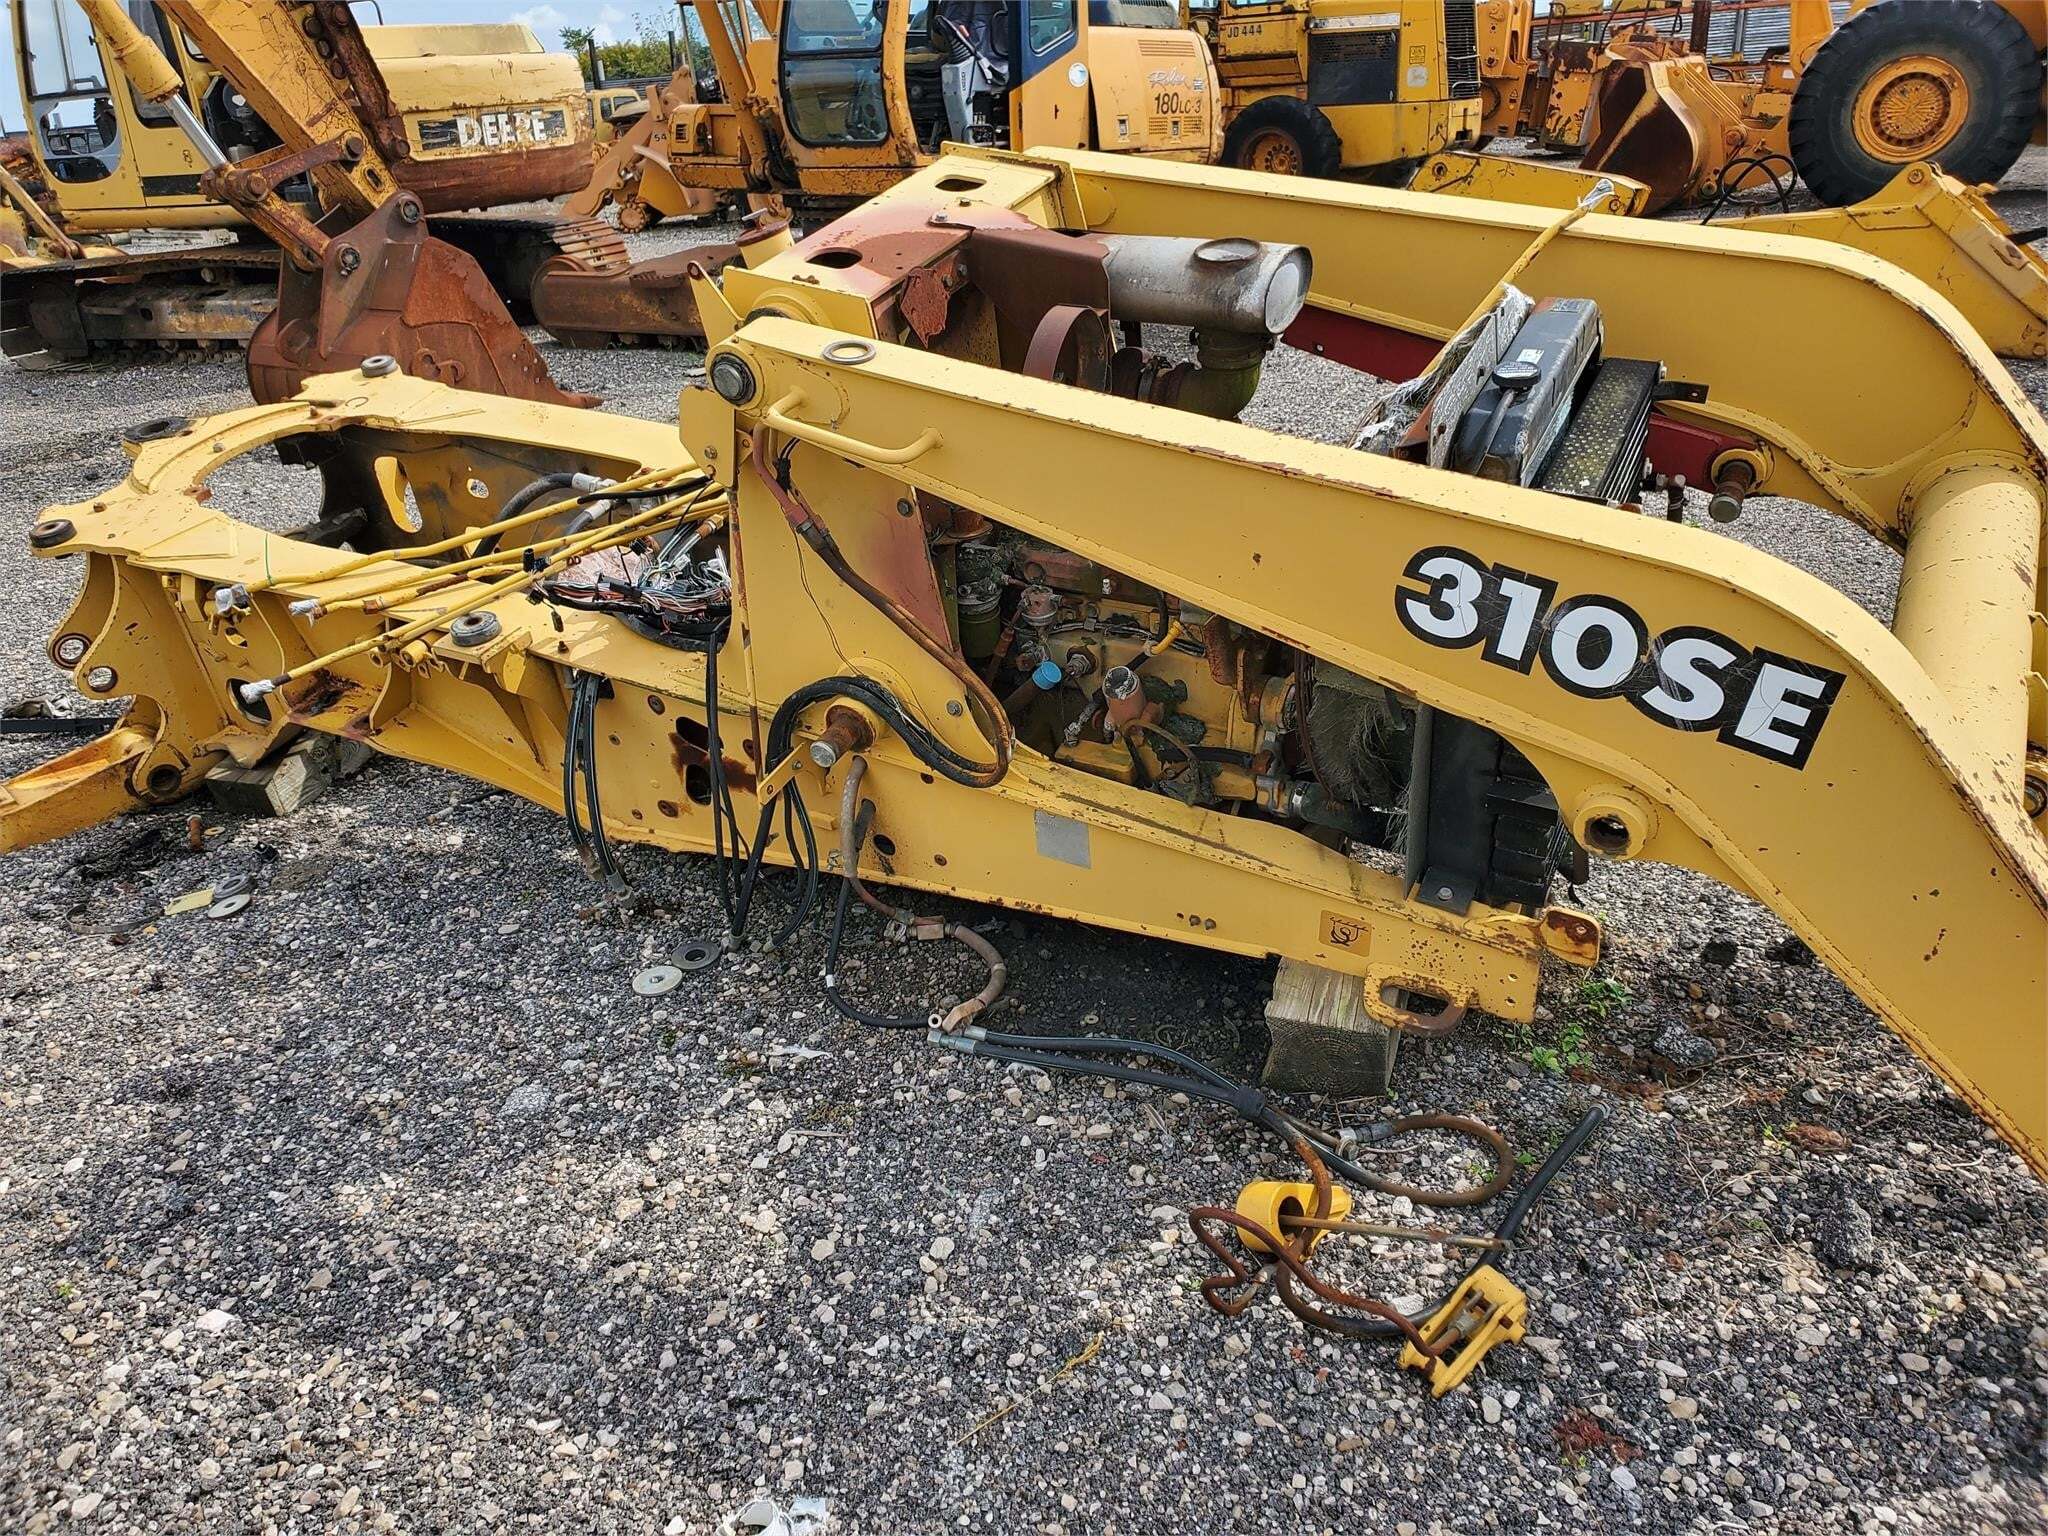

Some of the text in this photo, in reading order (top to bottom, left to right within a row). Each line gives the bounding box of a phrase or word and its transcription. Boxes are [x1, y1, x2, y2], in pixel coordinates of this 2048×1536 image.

[1227, 24, 1262, 38] JD 444
[1396, 546, 1846, 770] 310SE
